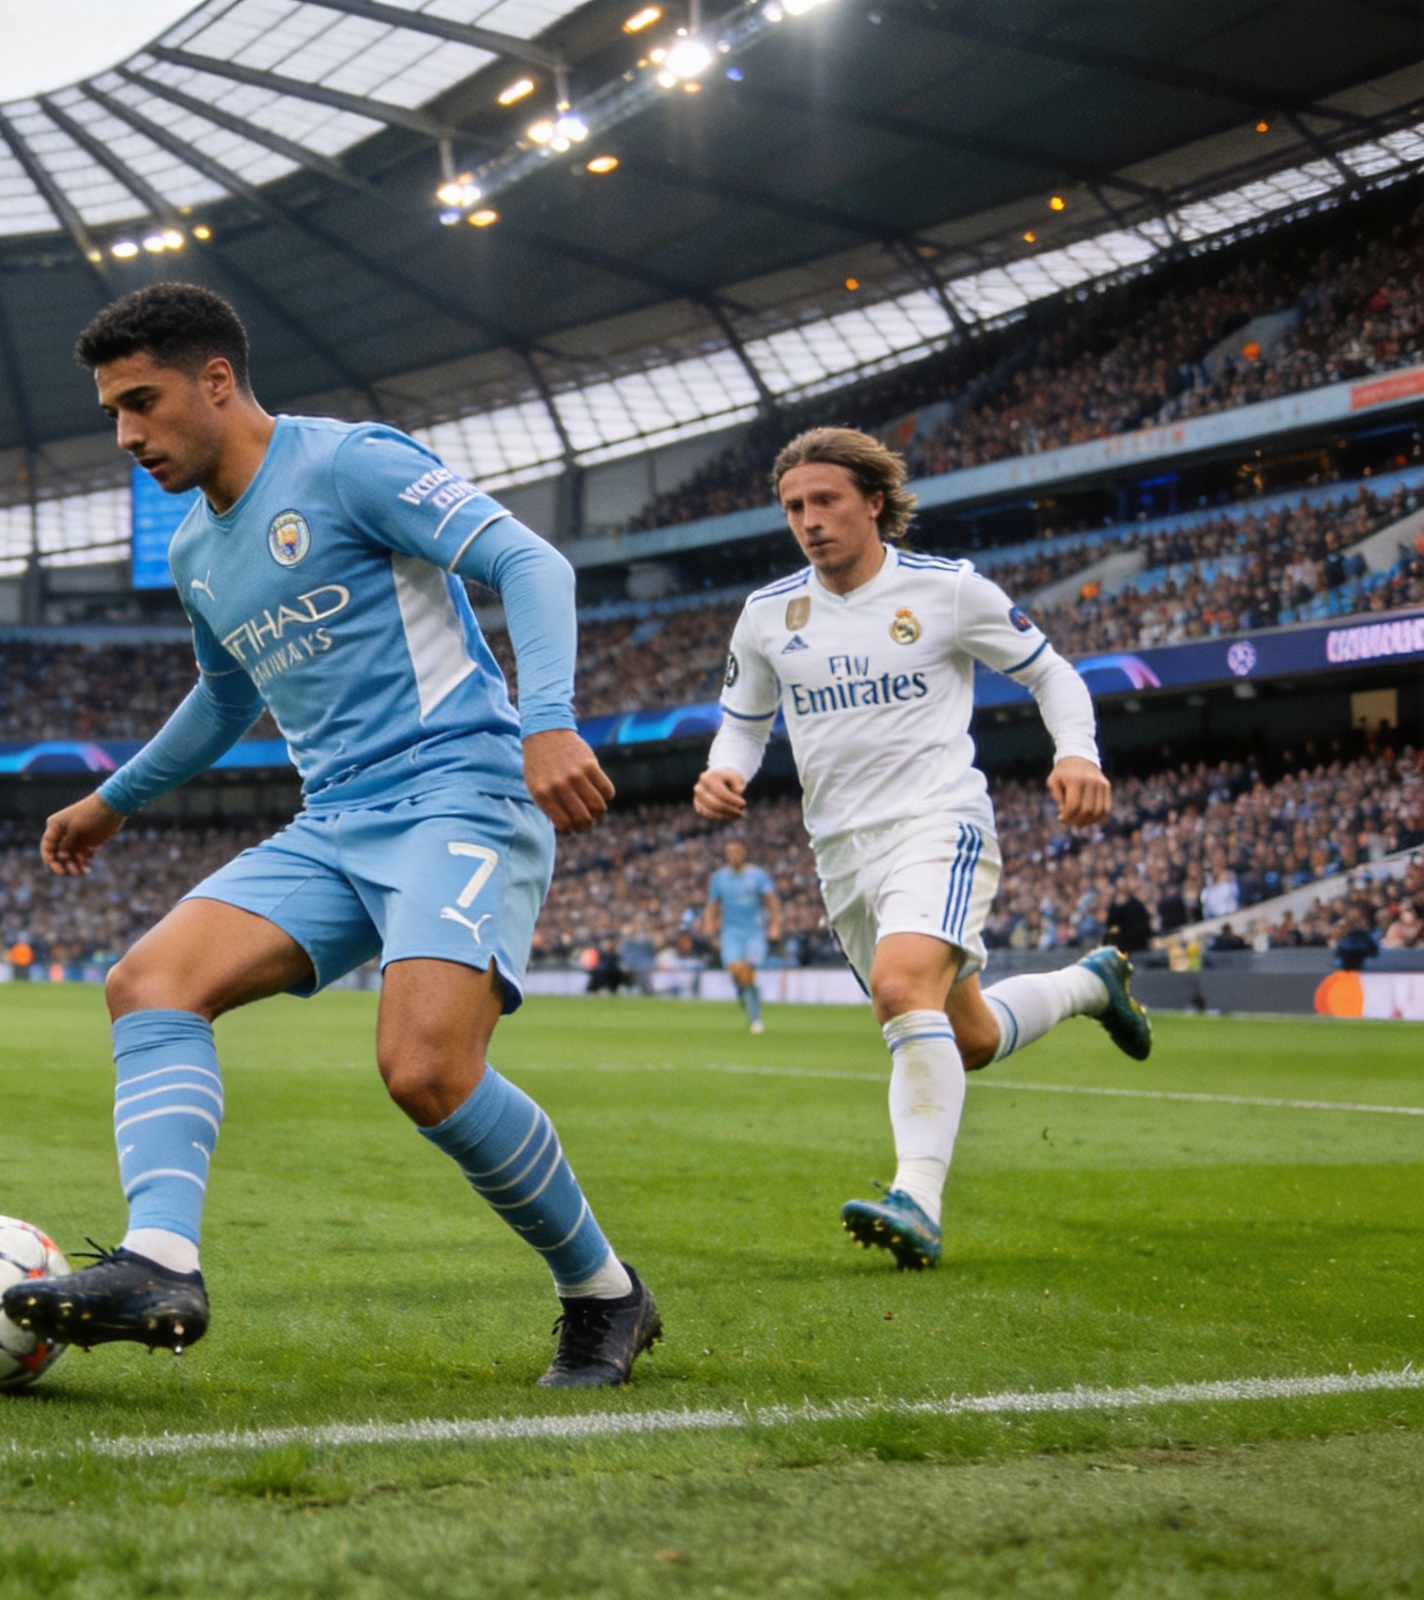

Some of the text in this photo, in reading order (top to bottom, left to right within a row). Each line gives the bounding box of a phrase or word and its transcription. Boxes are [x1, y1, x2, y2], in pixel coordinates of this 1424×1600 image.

[221, 584, 351, 660] TIHAD
[789, 671, 929, 717] Emirates
[447, 841, 499, 909] 7
